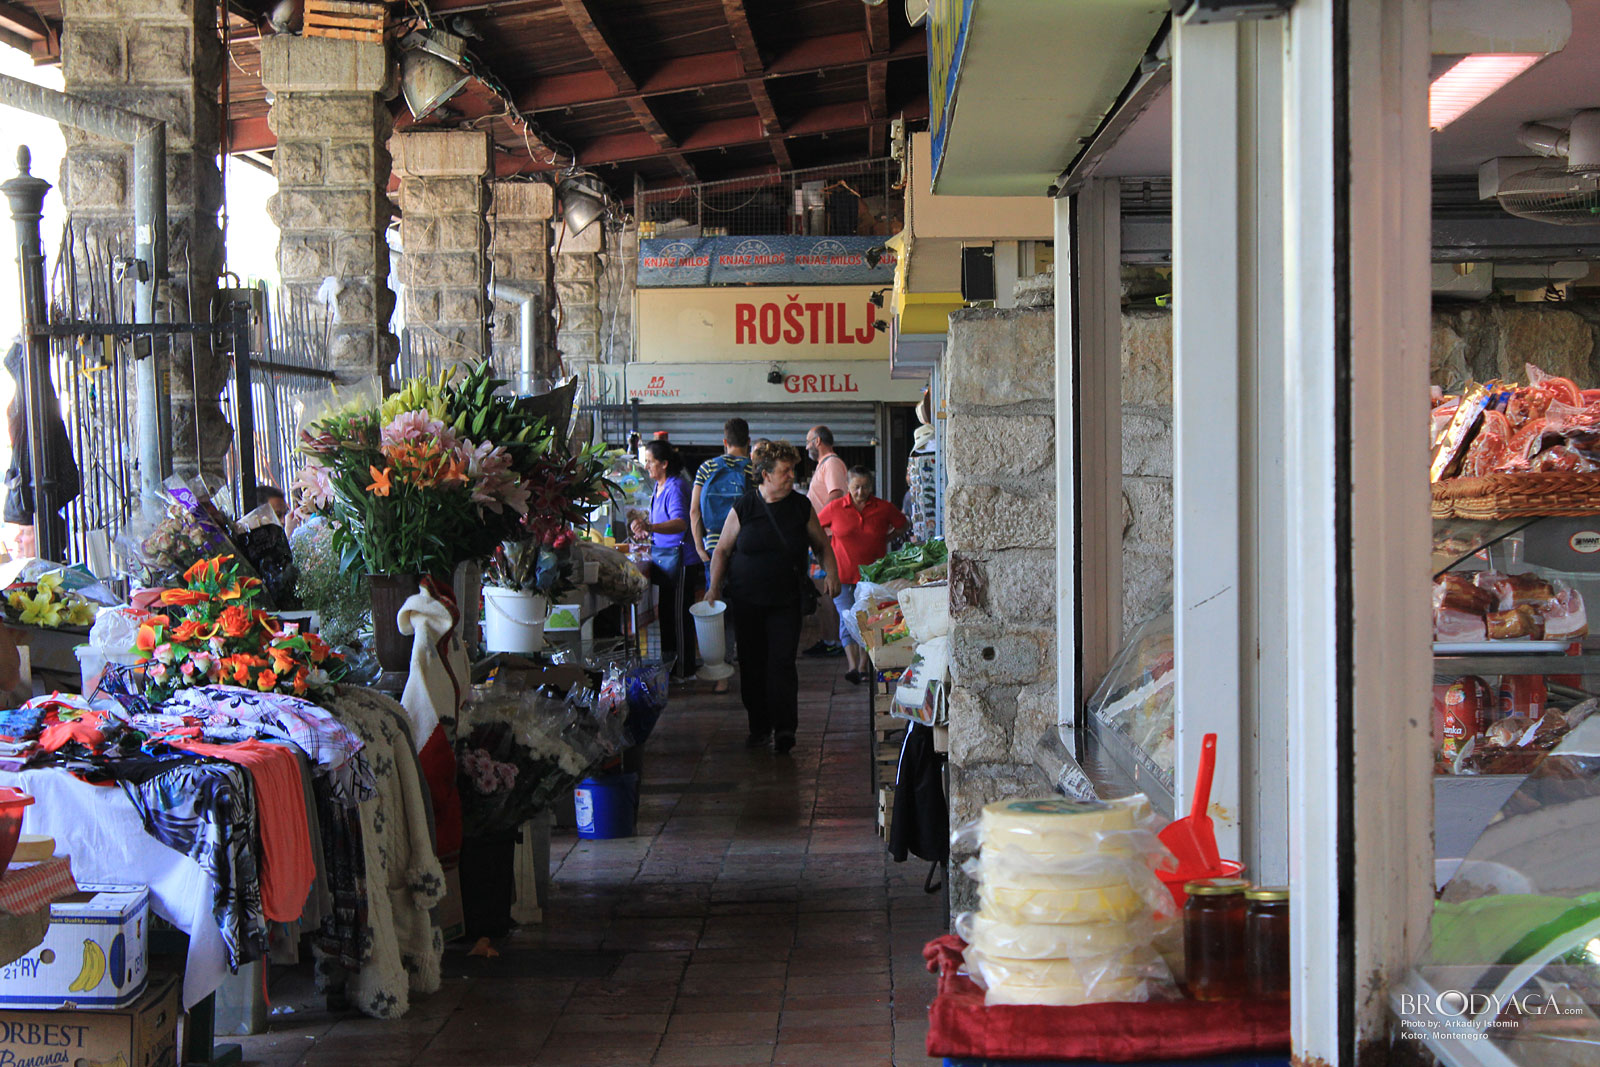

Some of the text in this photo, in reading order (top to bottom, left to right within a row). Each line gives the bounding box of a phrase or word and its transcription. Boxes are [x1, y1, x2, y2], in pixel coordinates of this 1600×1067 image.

[644, 255, 710, 267] KNJAZ MILOŠ
[719, 252, 785, 265] KNJAZ MILOŠ
[795, 253, 862, 265] KNJAZ MILOŠ
[879, 255, 897, 265] NJA
[735, 293, 875, 345] ROŠTILJ
[784, 373, 859, 394] GRILL
[4, 967, 17, 980] 21
